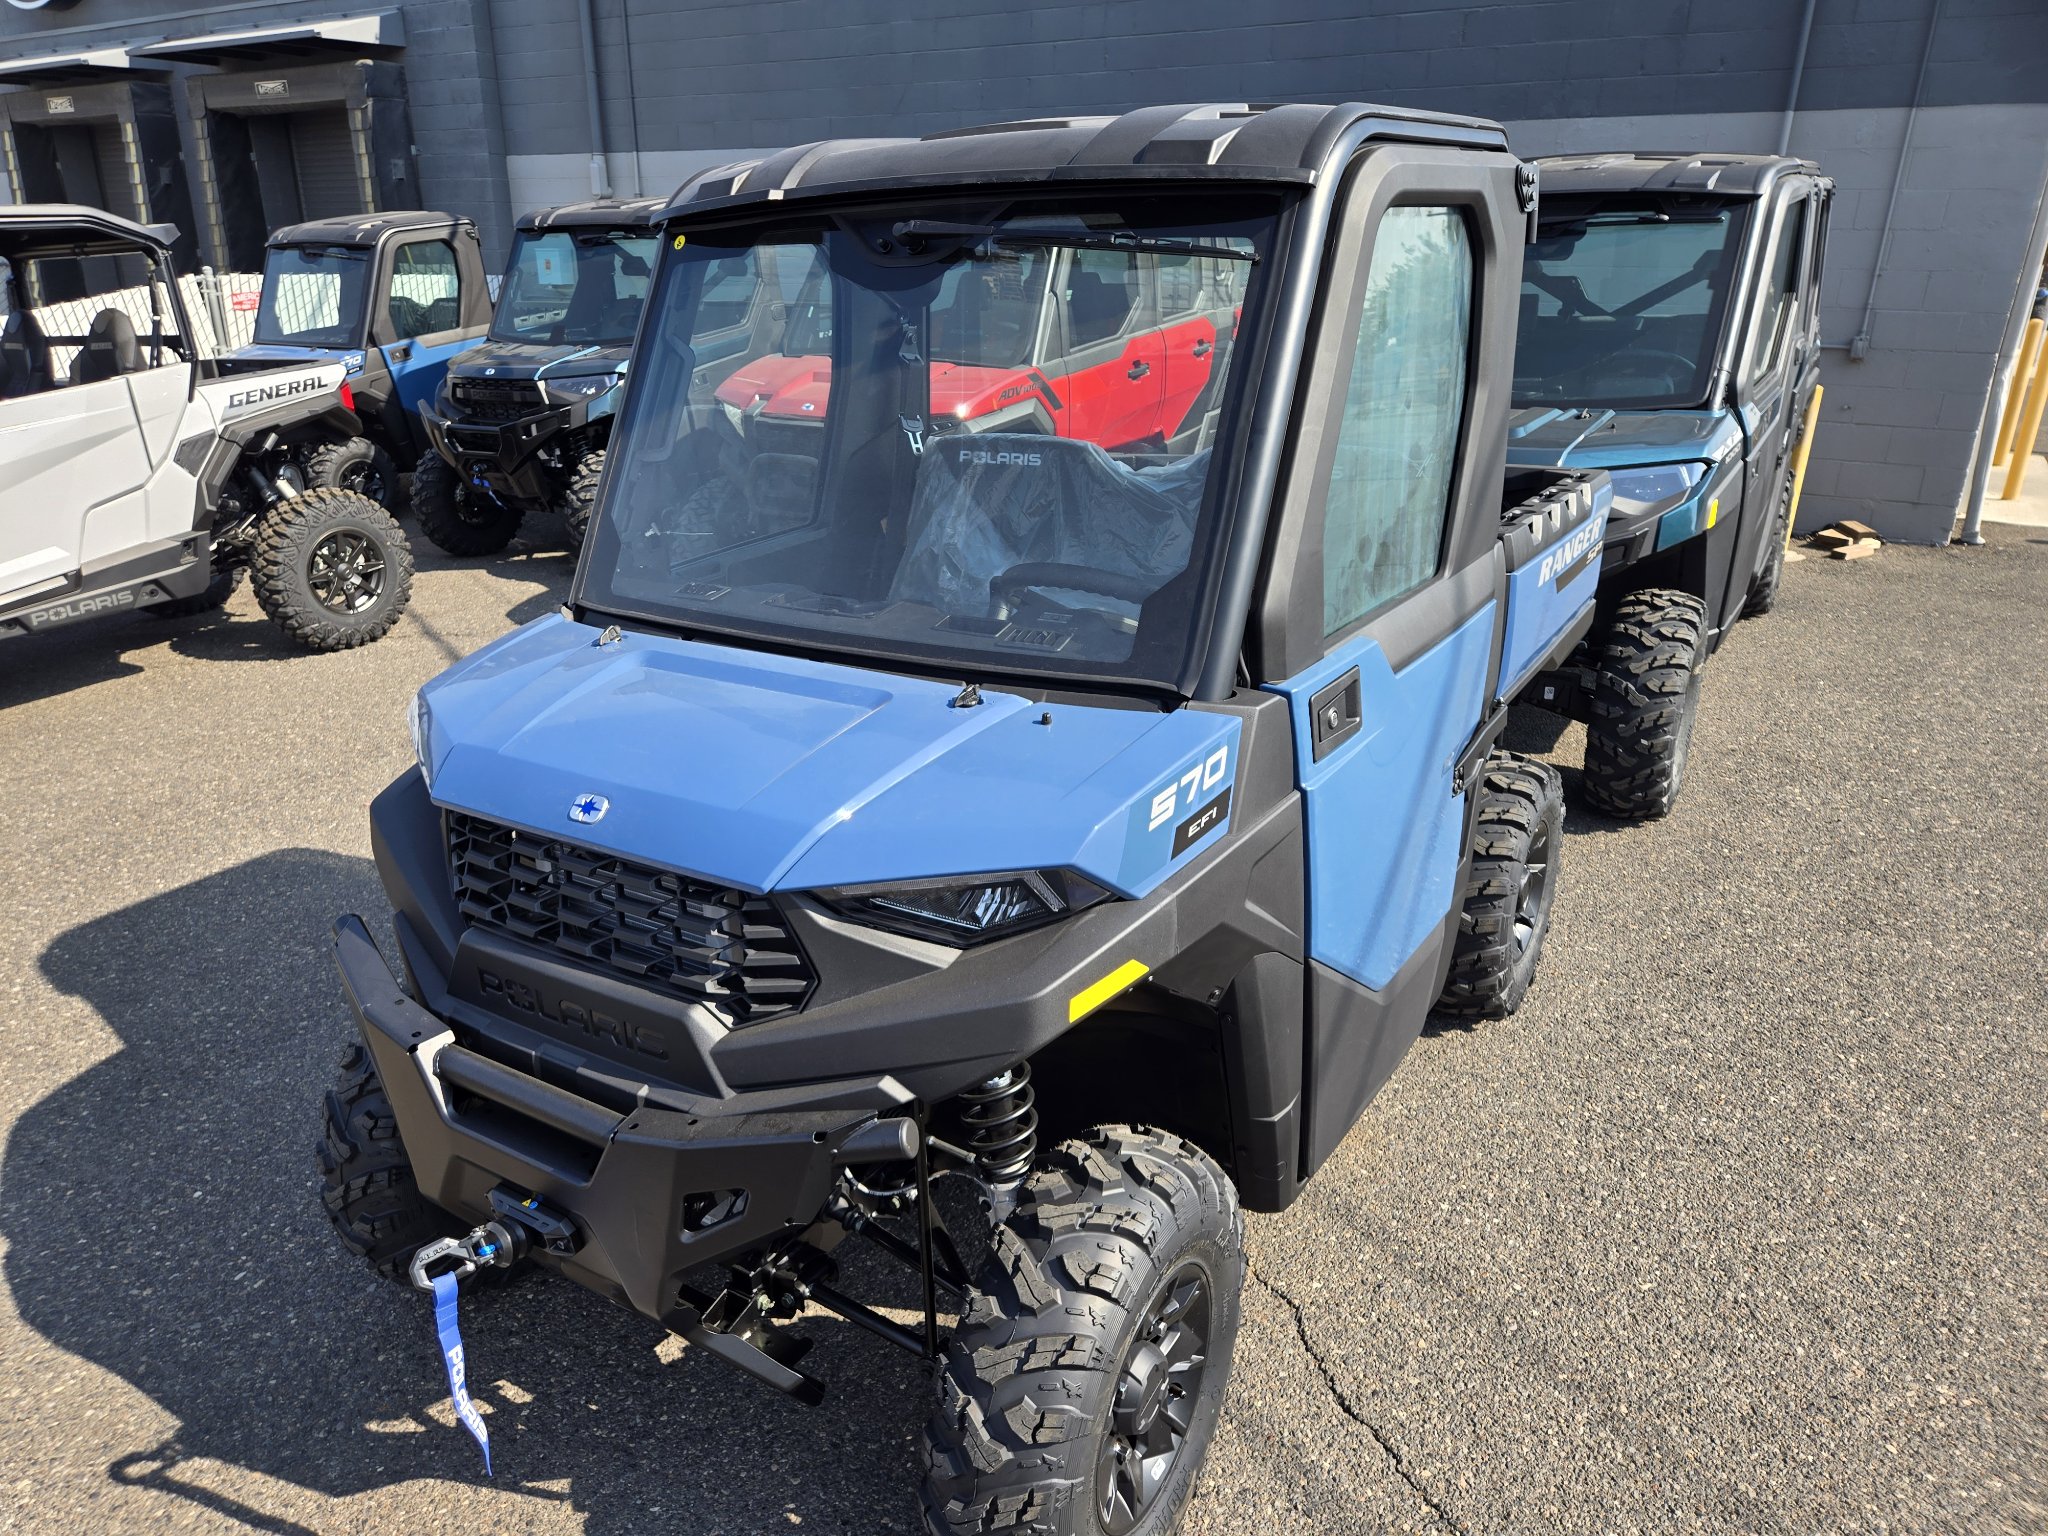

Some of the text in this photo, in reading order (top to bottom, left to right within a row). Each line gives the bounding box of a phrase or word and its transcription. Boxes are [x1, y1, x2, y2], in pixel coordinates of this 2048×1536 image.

[229, 376, 328, 409] GENERAL
[998, 384, 1023, 401] ADV
[959, 450, 1042, 467] POLARIS
[1537, 516, 1602, 588] RANGER
[31, 590, 134, 626] POLARIS
[1148, 744, 1228, 833] 570
[1187, 806, 1217, 838] EFI
[477, 966, 671, 1062] POLARIS
[448, 1344, 488, 1442] POLARIS
